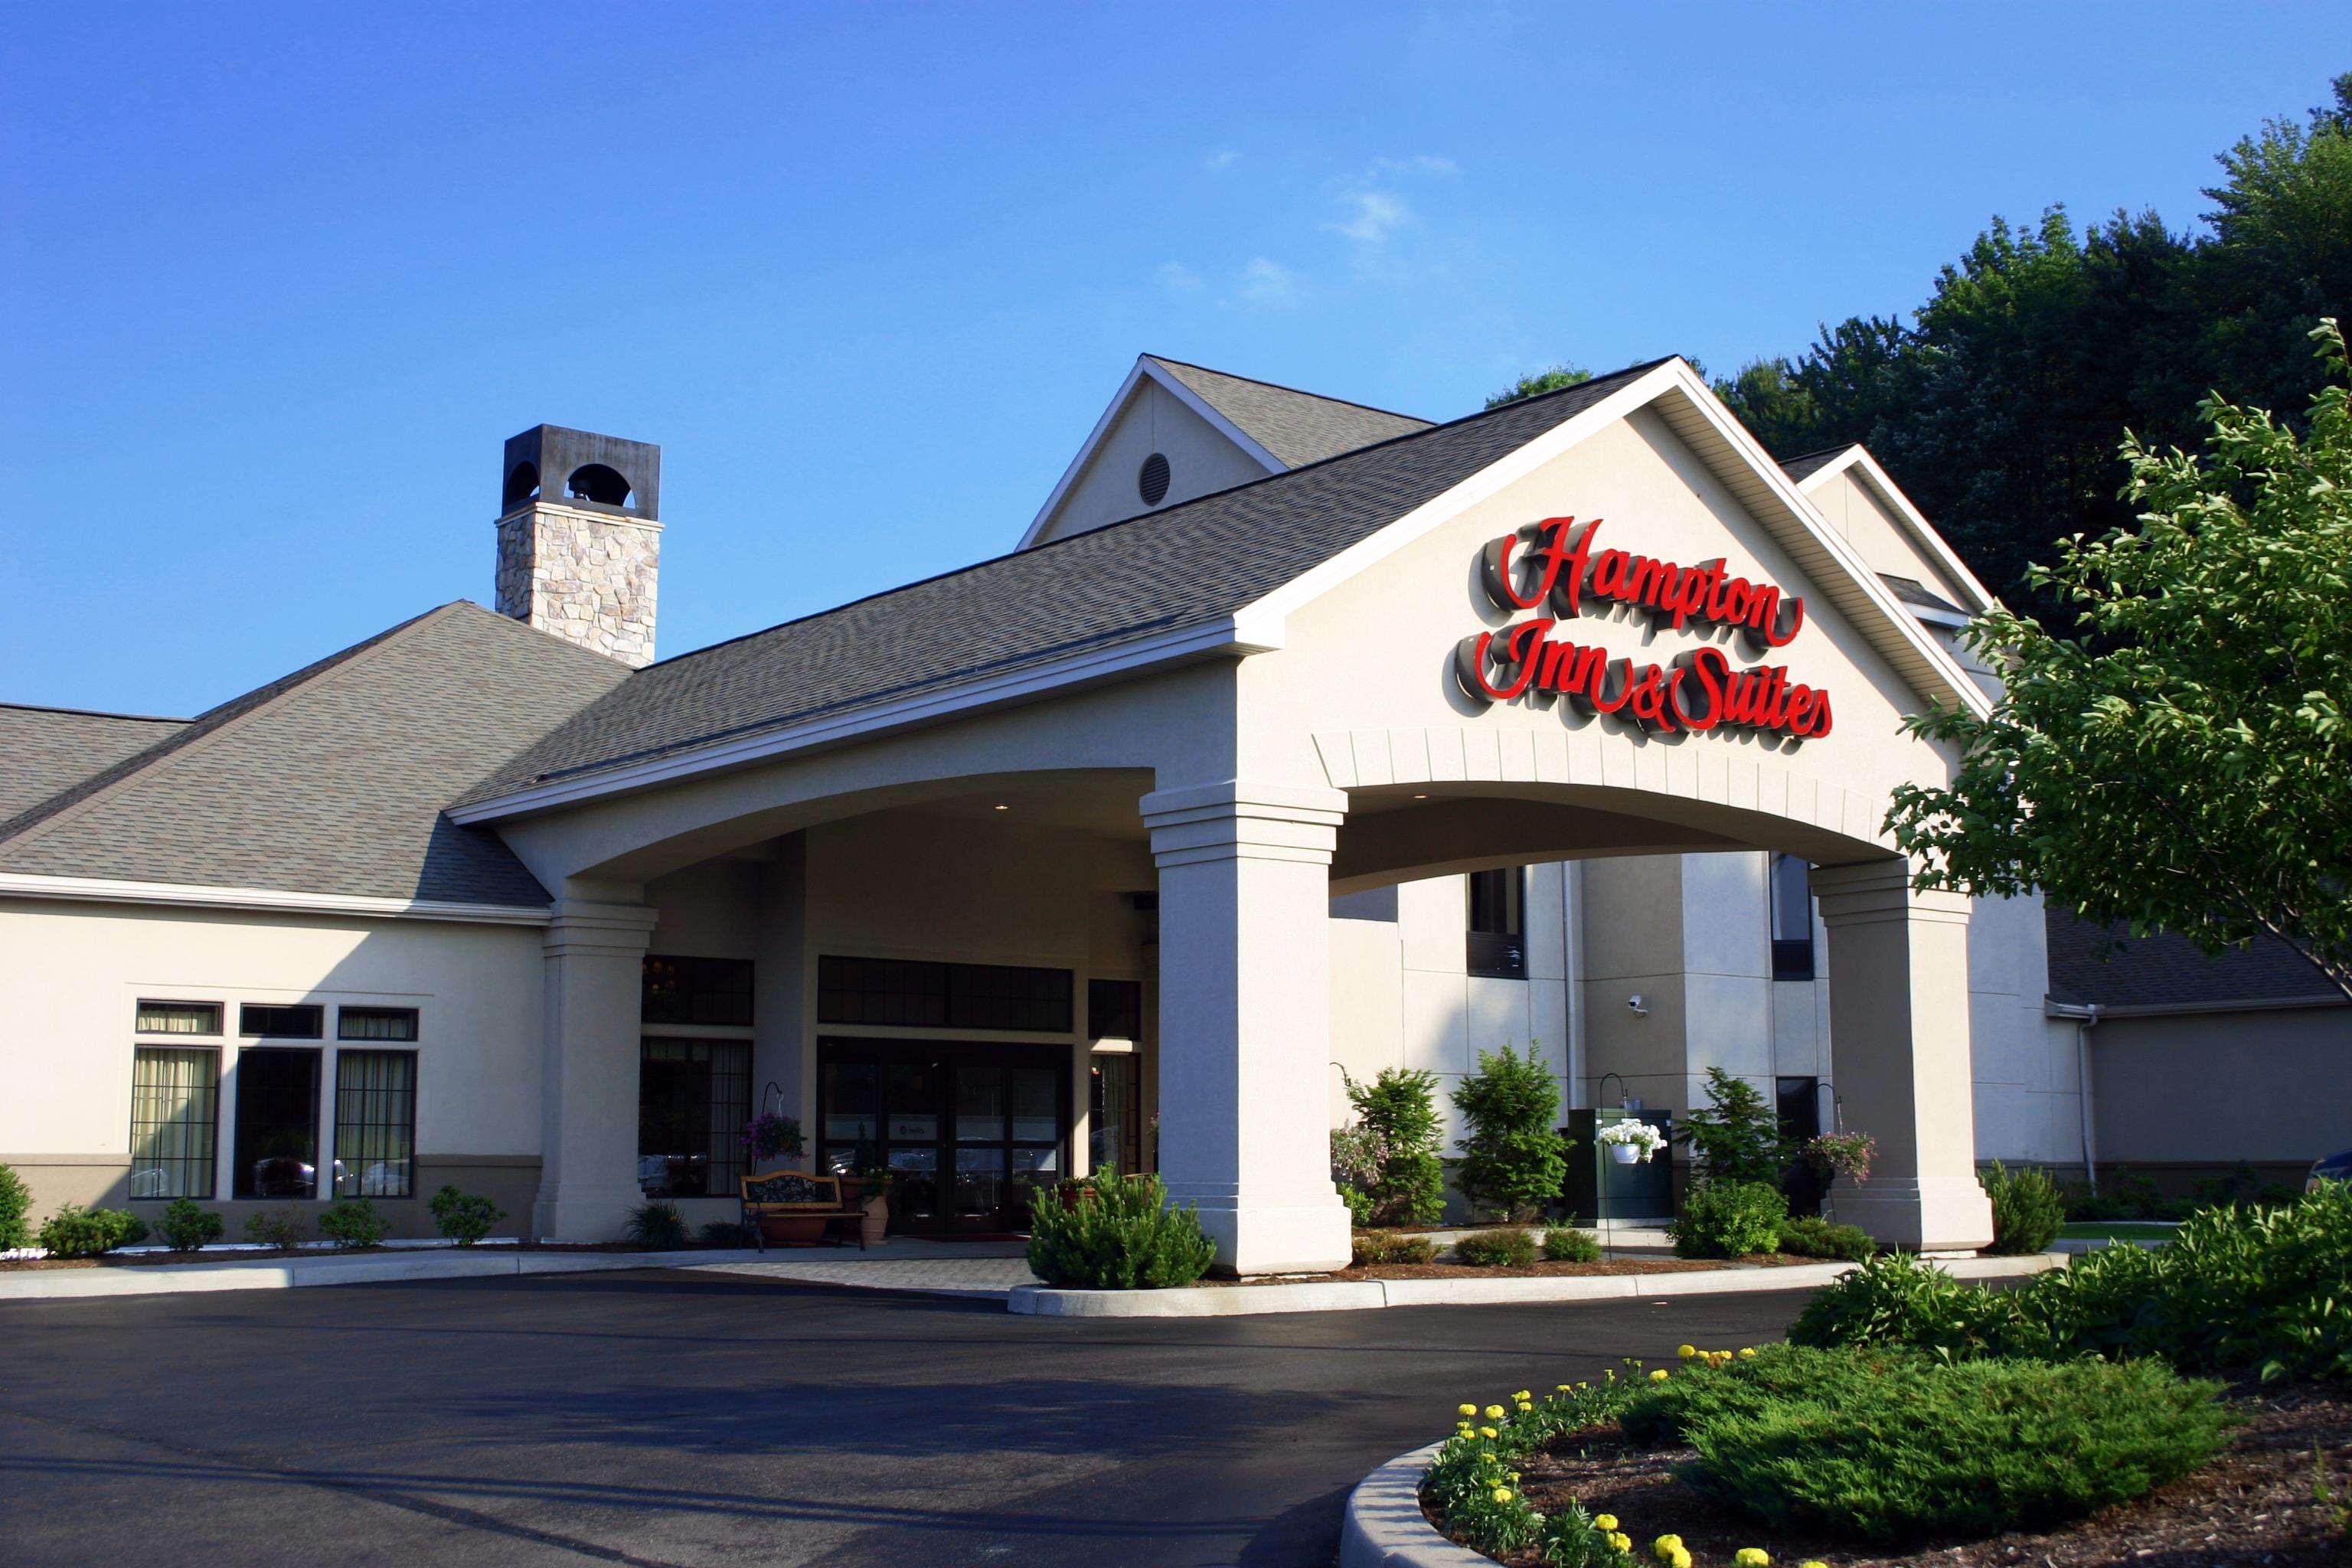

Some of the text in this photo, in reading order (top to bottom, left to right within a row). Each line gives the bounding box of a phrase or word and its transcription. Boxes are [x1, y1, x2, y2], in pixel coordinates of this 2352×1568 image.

[1498, 515, 1804, 648] Hampton
[1473, 618, 1833, 739] Inn & Suites
